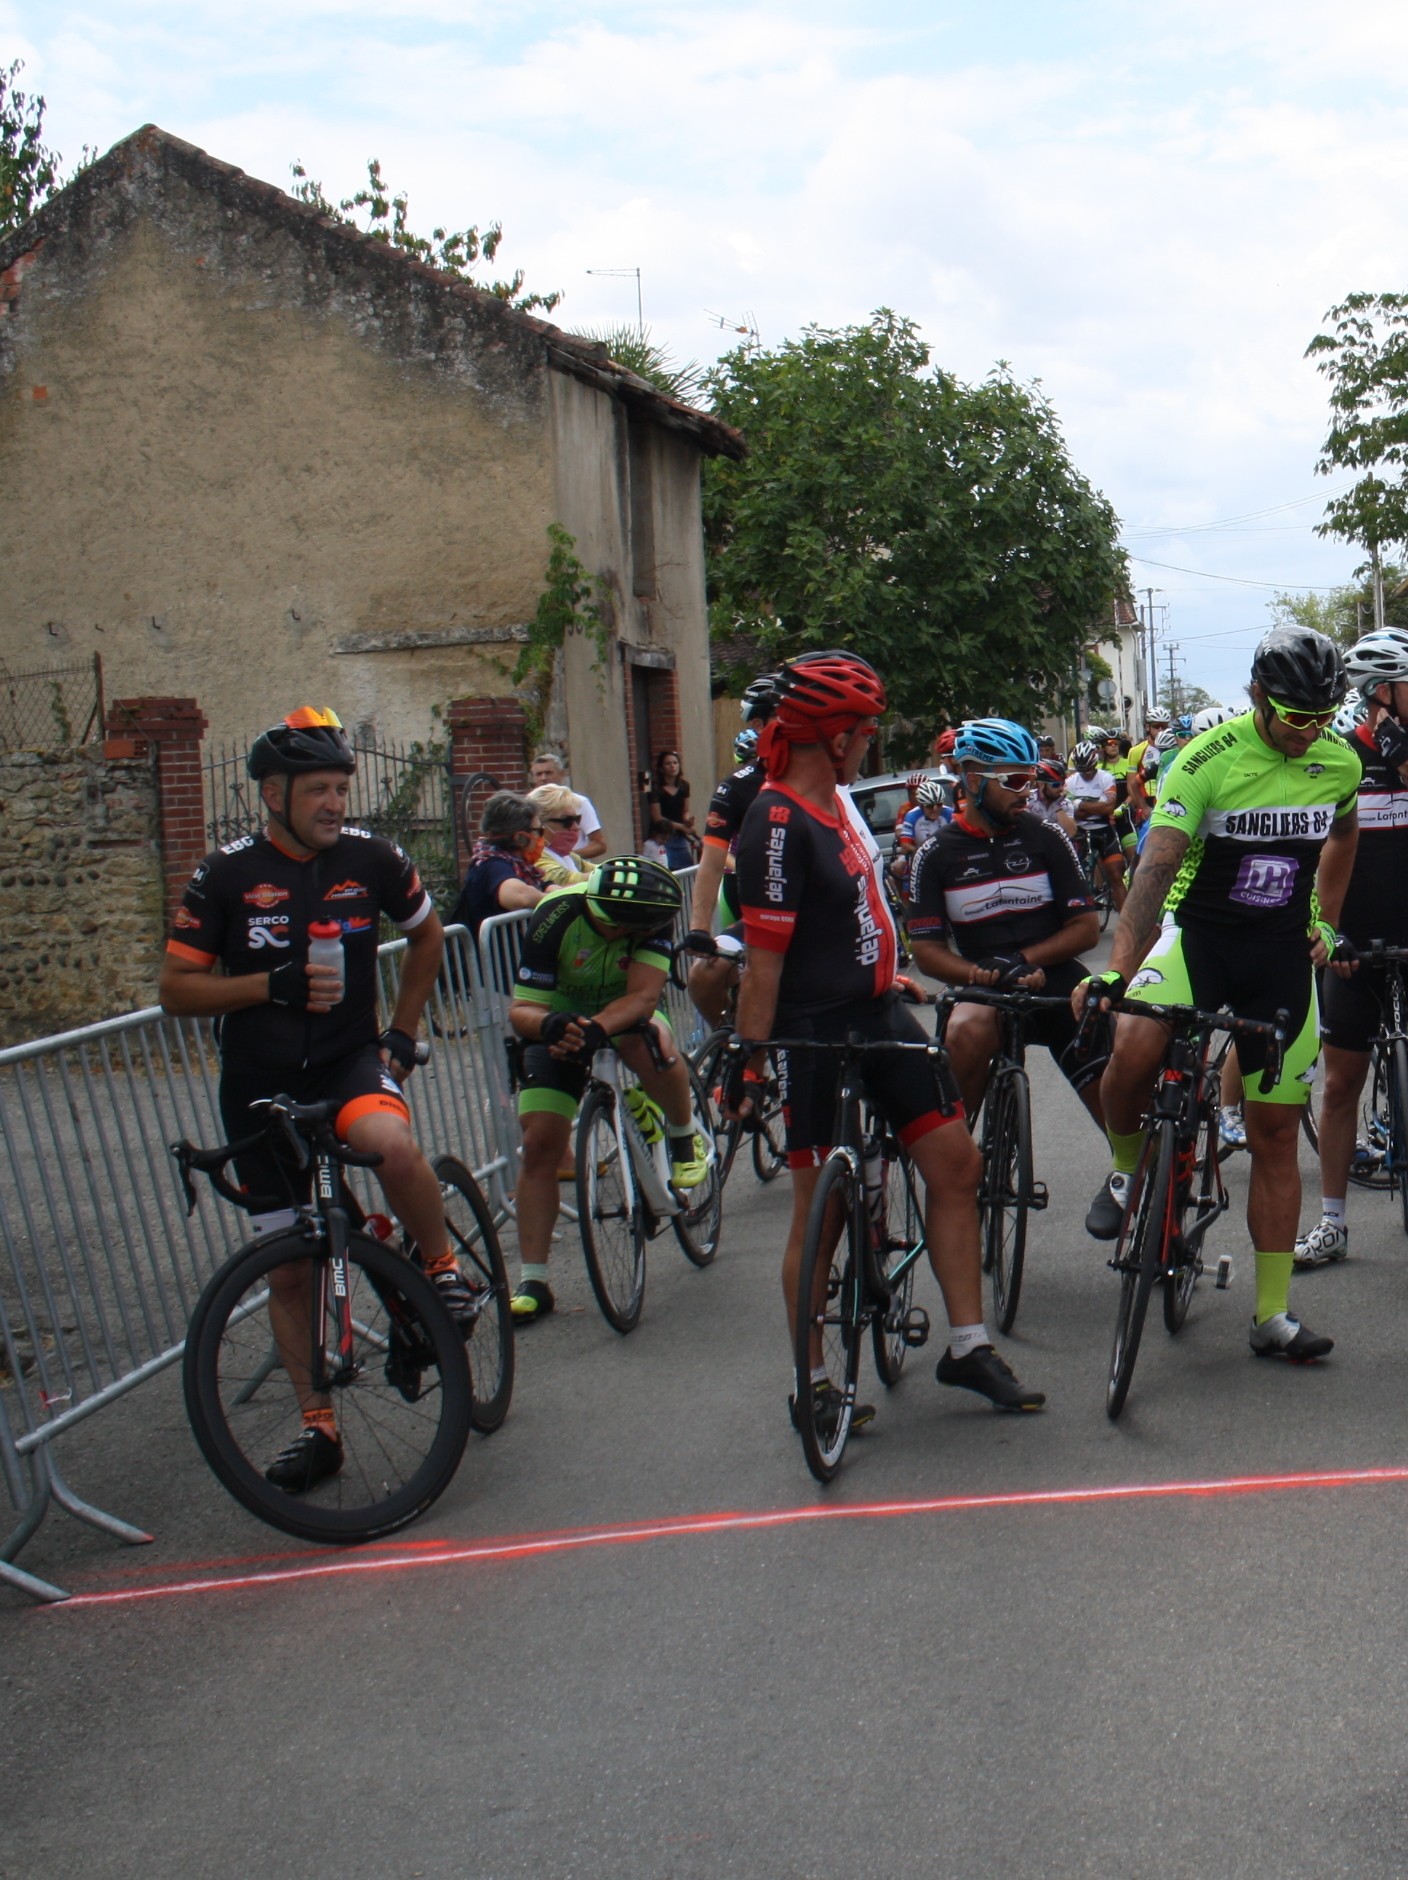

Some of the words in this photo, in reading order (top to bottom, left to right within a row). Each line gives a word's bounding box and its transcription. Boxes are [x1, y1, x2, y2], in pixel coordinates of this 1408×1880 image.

[1182, 740, 1226, 775] SANGLIERS
[733, 766, 754, 778] EBC
[340, 826, 371, 839] EBC
[1226, 812, 1310, 837] SANGLIERS
[221, 835, 254, 855] EBC
[248, 915, 289, 926] SERCO
[533, 900, 570, 944] EDELWEISS
[317, 1155, 333, 1199] BMC
[332, 1257, 346, 1297] BMC
